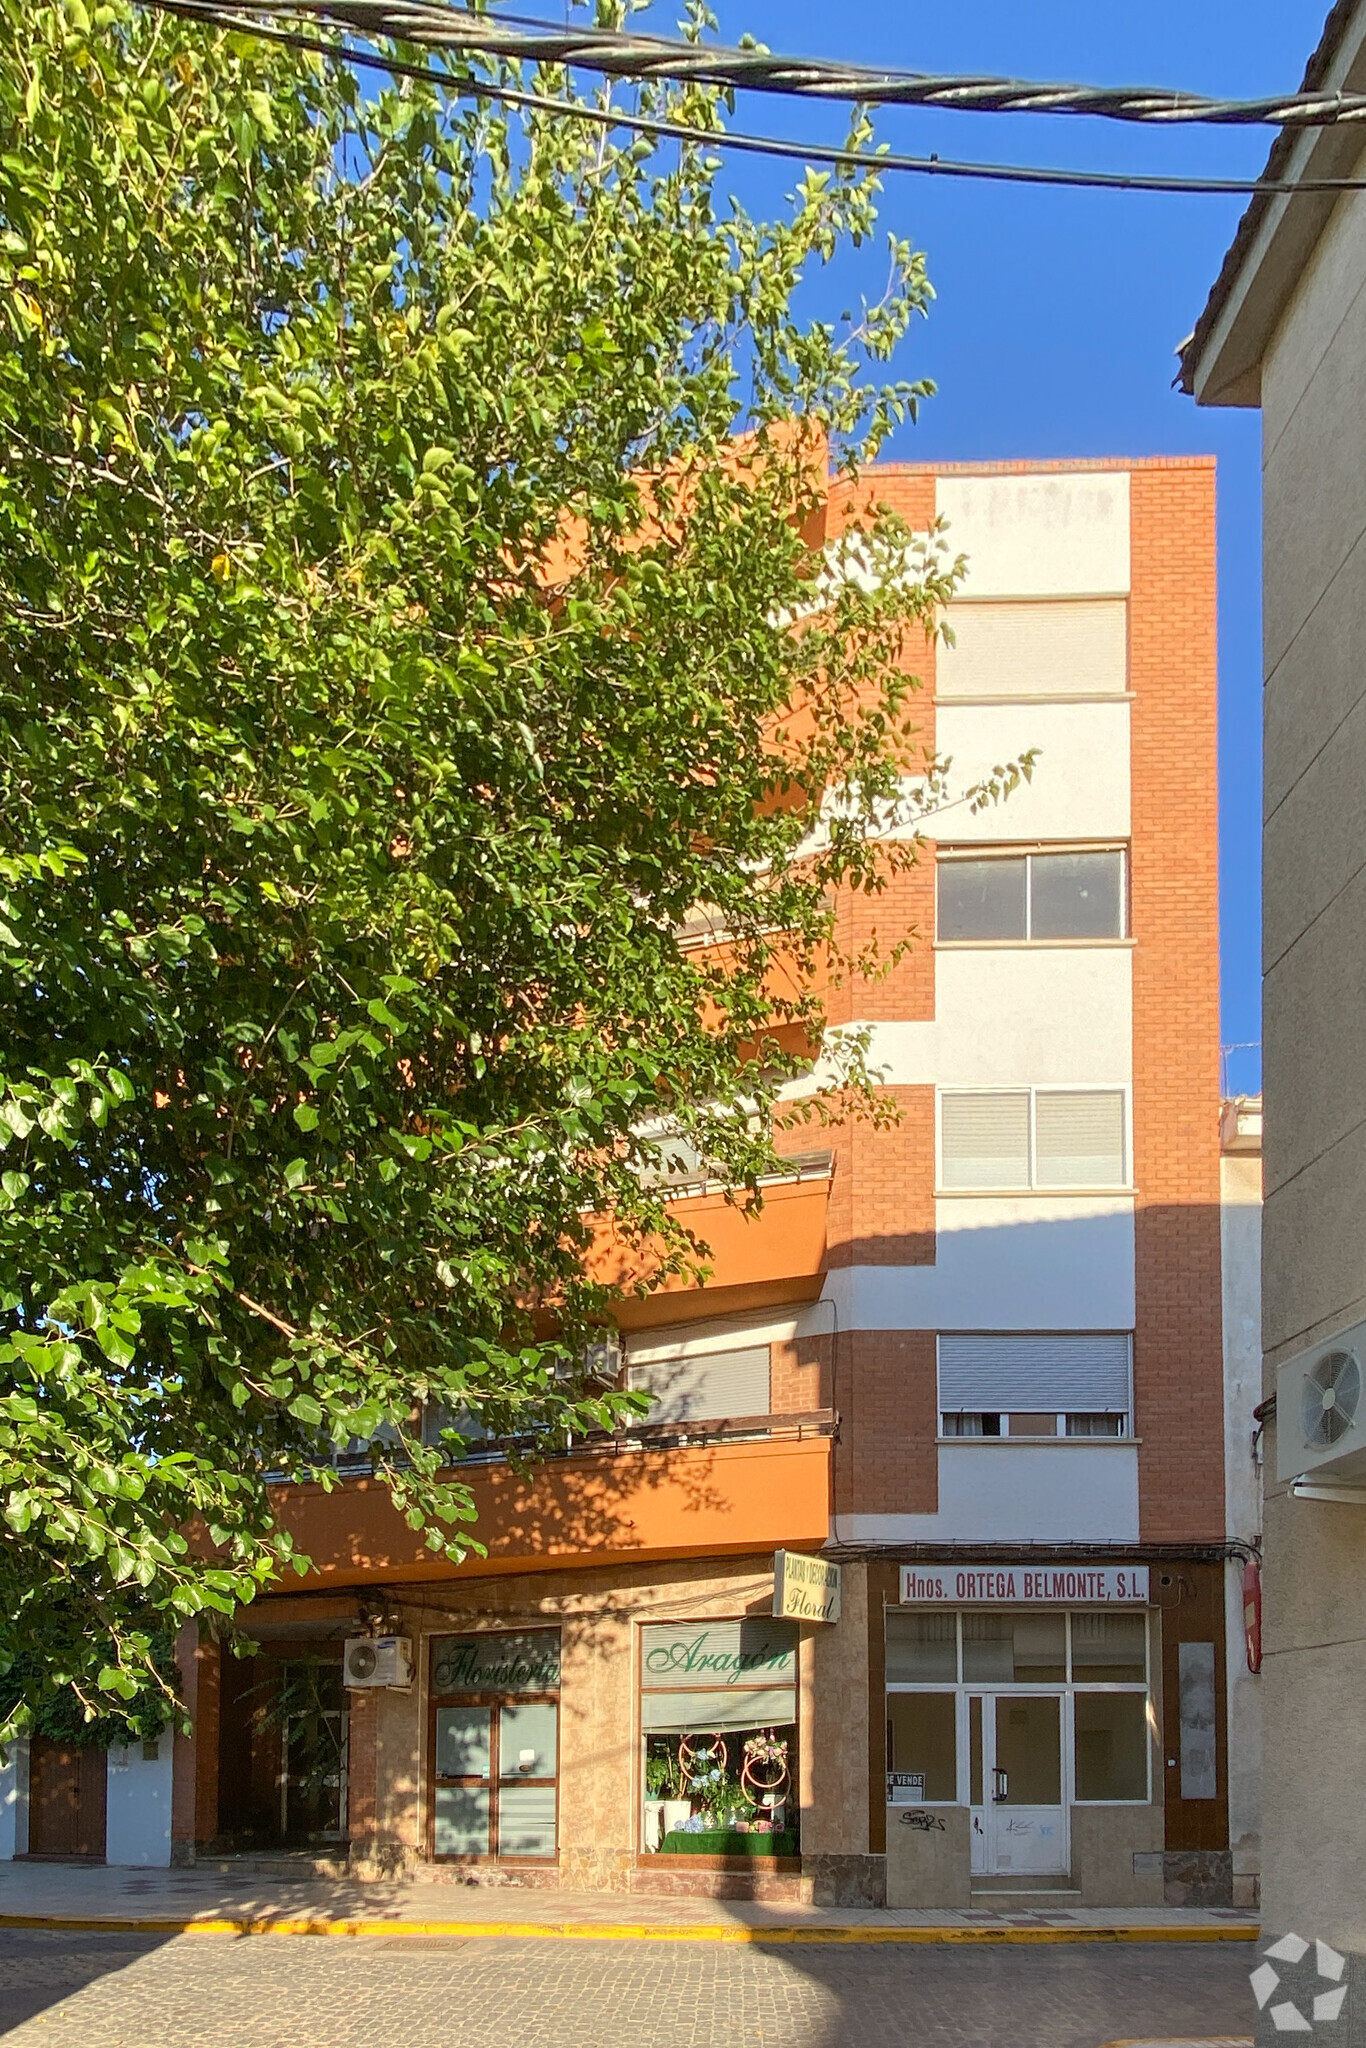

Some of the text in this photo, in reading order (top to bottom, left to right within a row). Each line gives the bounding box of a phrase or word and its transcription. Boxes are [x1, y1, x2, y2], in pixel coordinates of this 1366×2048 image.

[906, 1572, 1145, 1600] Hnos. ORTEGA BELMONTE, S.L.
[786, 1588, 834, 1618] Floral
[646, 1631, 791, 1685] Aragón
[896, 1775, 923, 1786] VENDE
